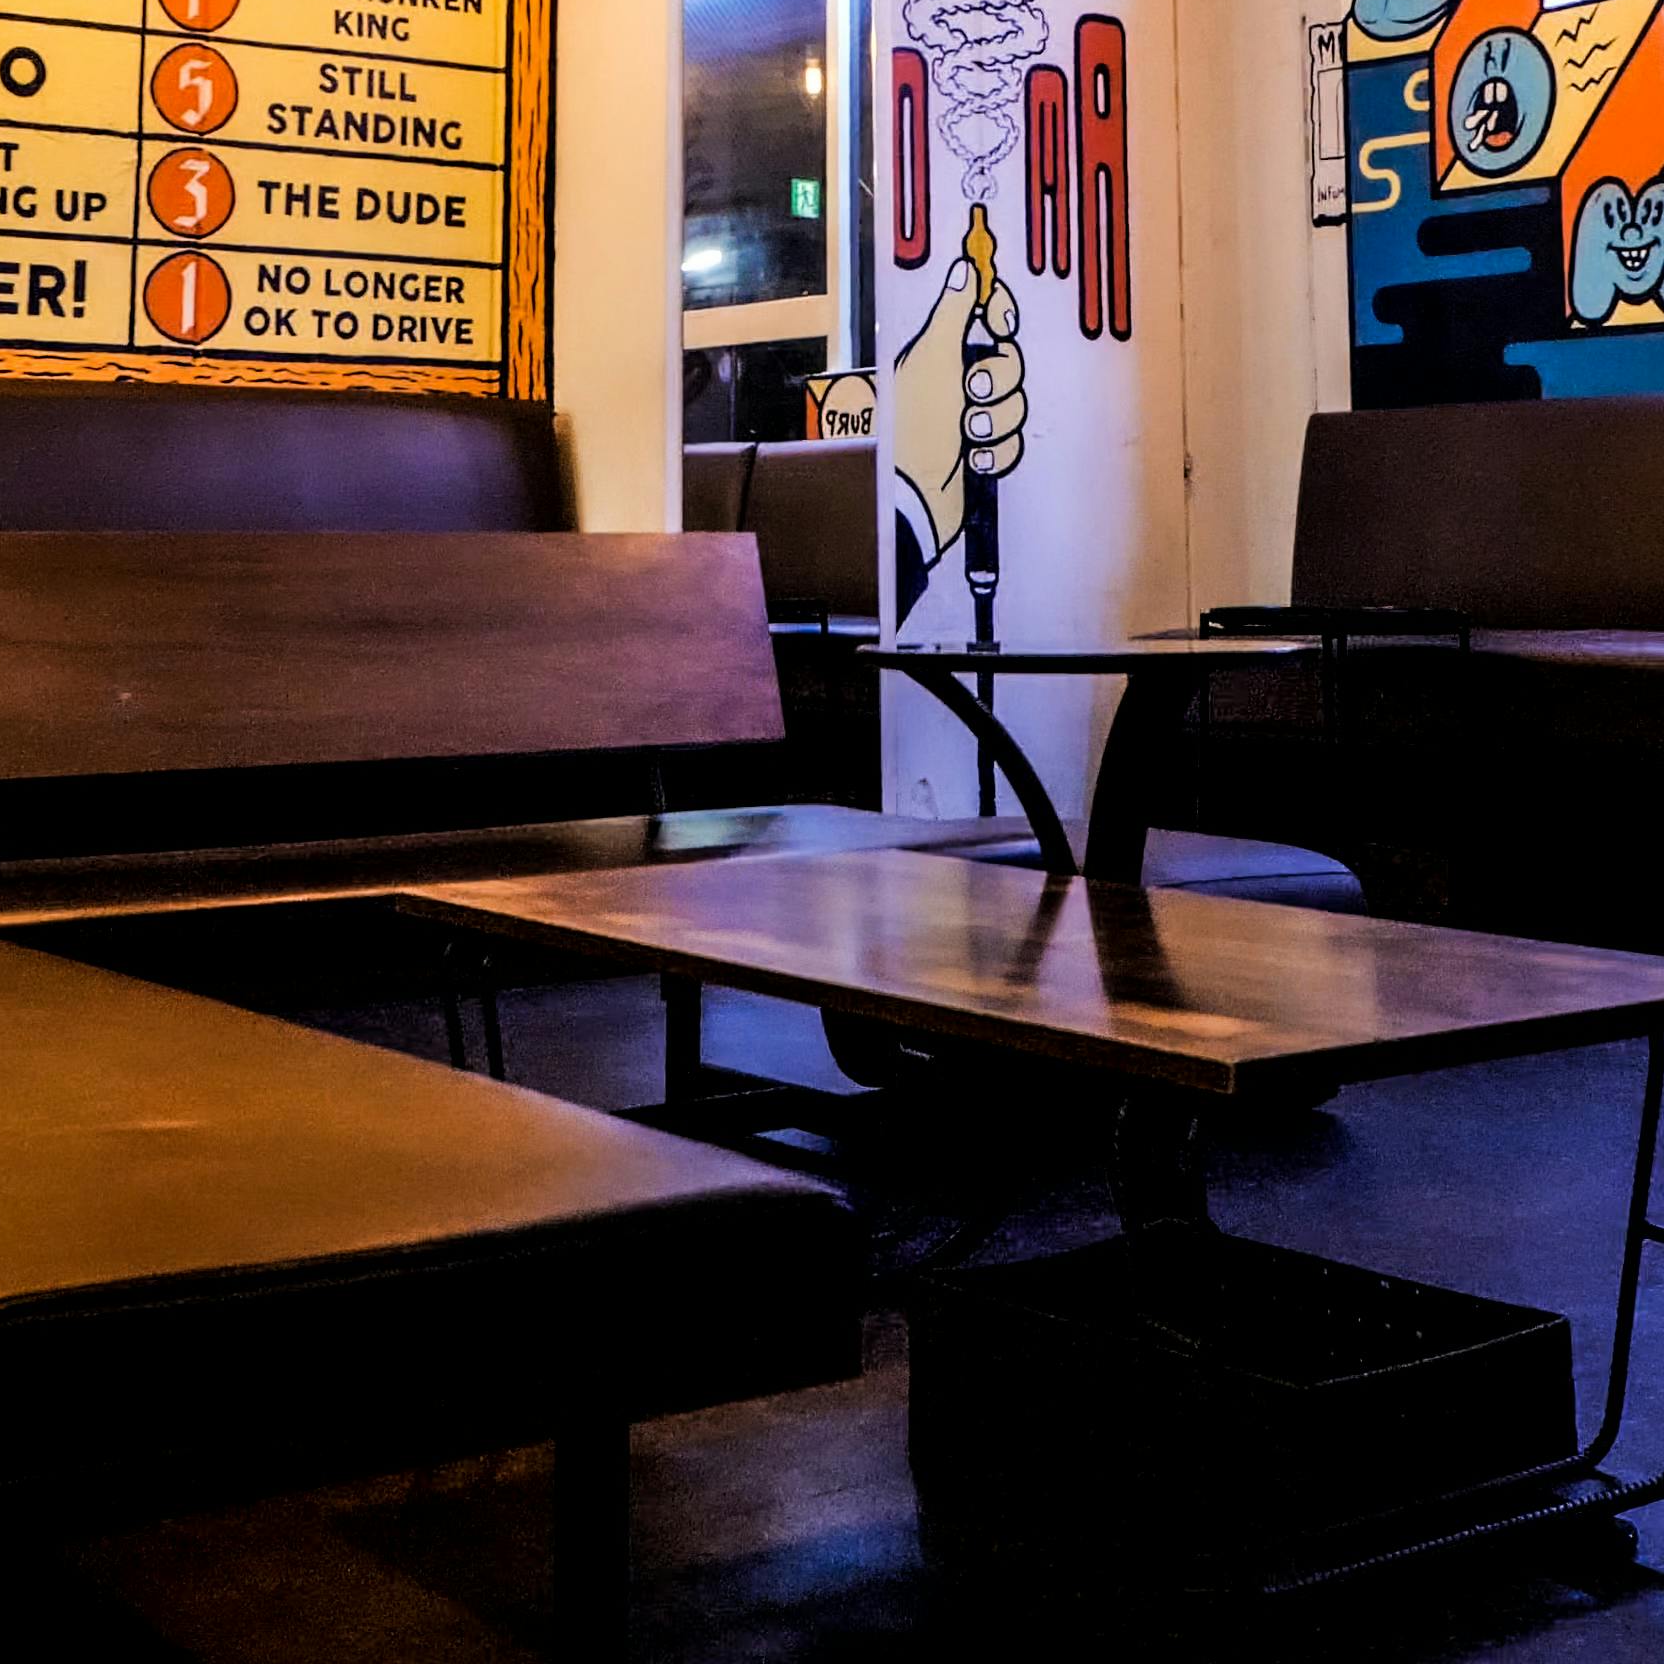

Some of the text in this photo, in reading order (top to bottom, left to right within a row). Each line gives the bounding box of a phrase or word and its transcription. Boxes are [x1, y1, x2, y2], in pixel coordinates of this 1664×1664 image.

[334, 9, 410, 42] KING
[178, 59, 214, 126] 5
[318, 62, 417, 103] STILL
[266, 103, 463, 151] STANDING
[55, 189, 108, 222] UP
[173, 158, 211, 228] 3
[257, 180, 467, 228] THE DUDE
[181, 260, 197, 335] 1
[257, 264, 465, 304] NO LONGER
[243, 305, 474, 345] OK TO DRIVE
